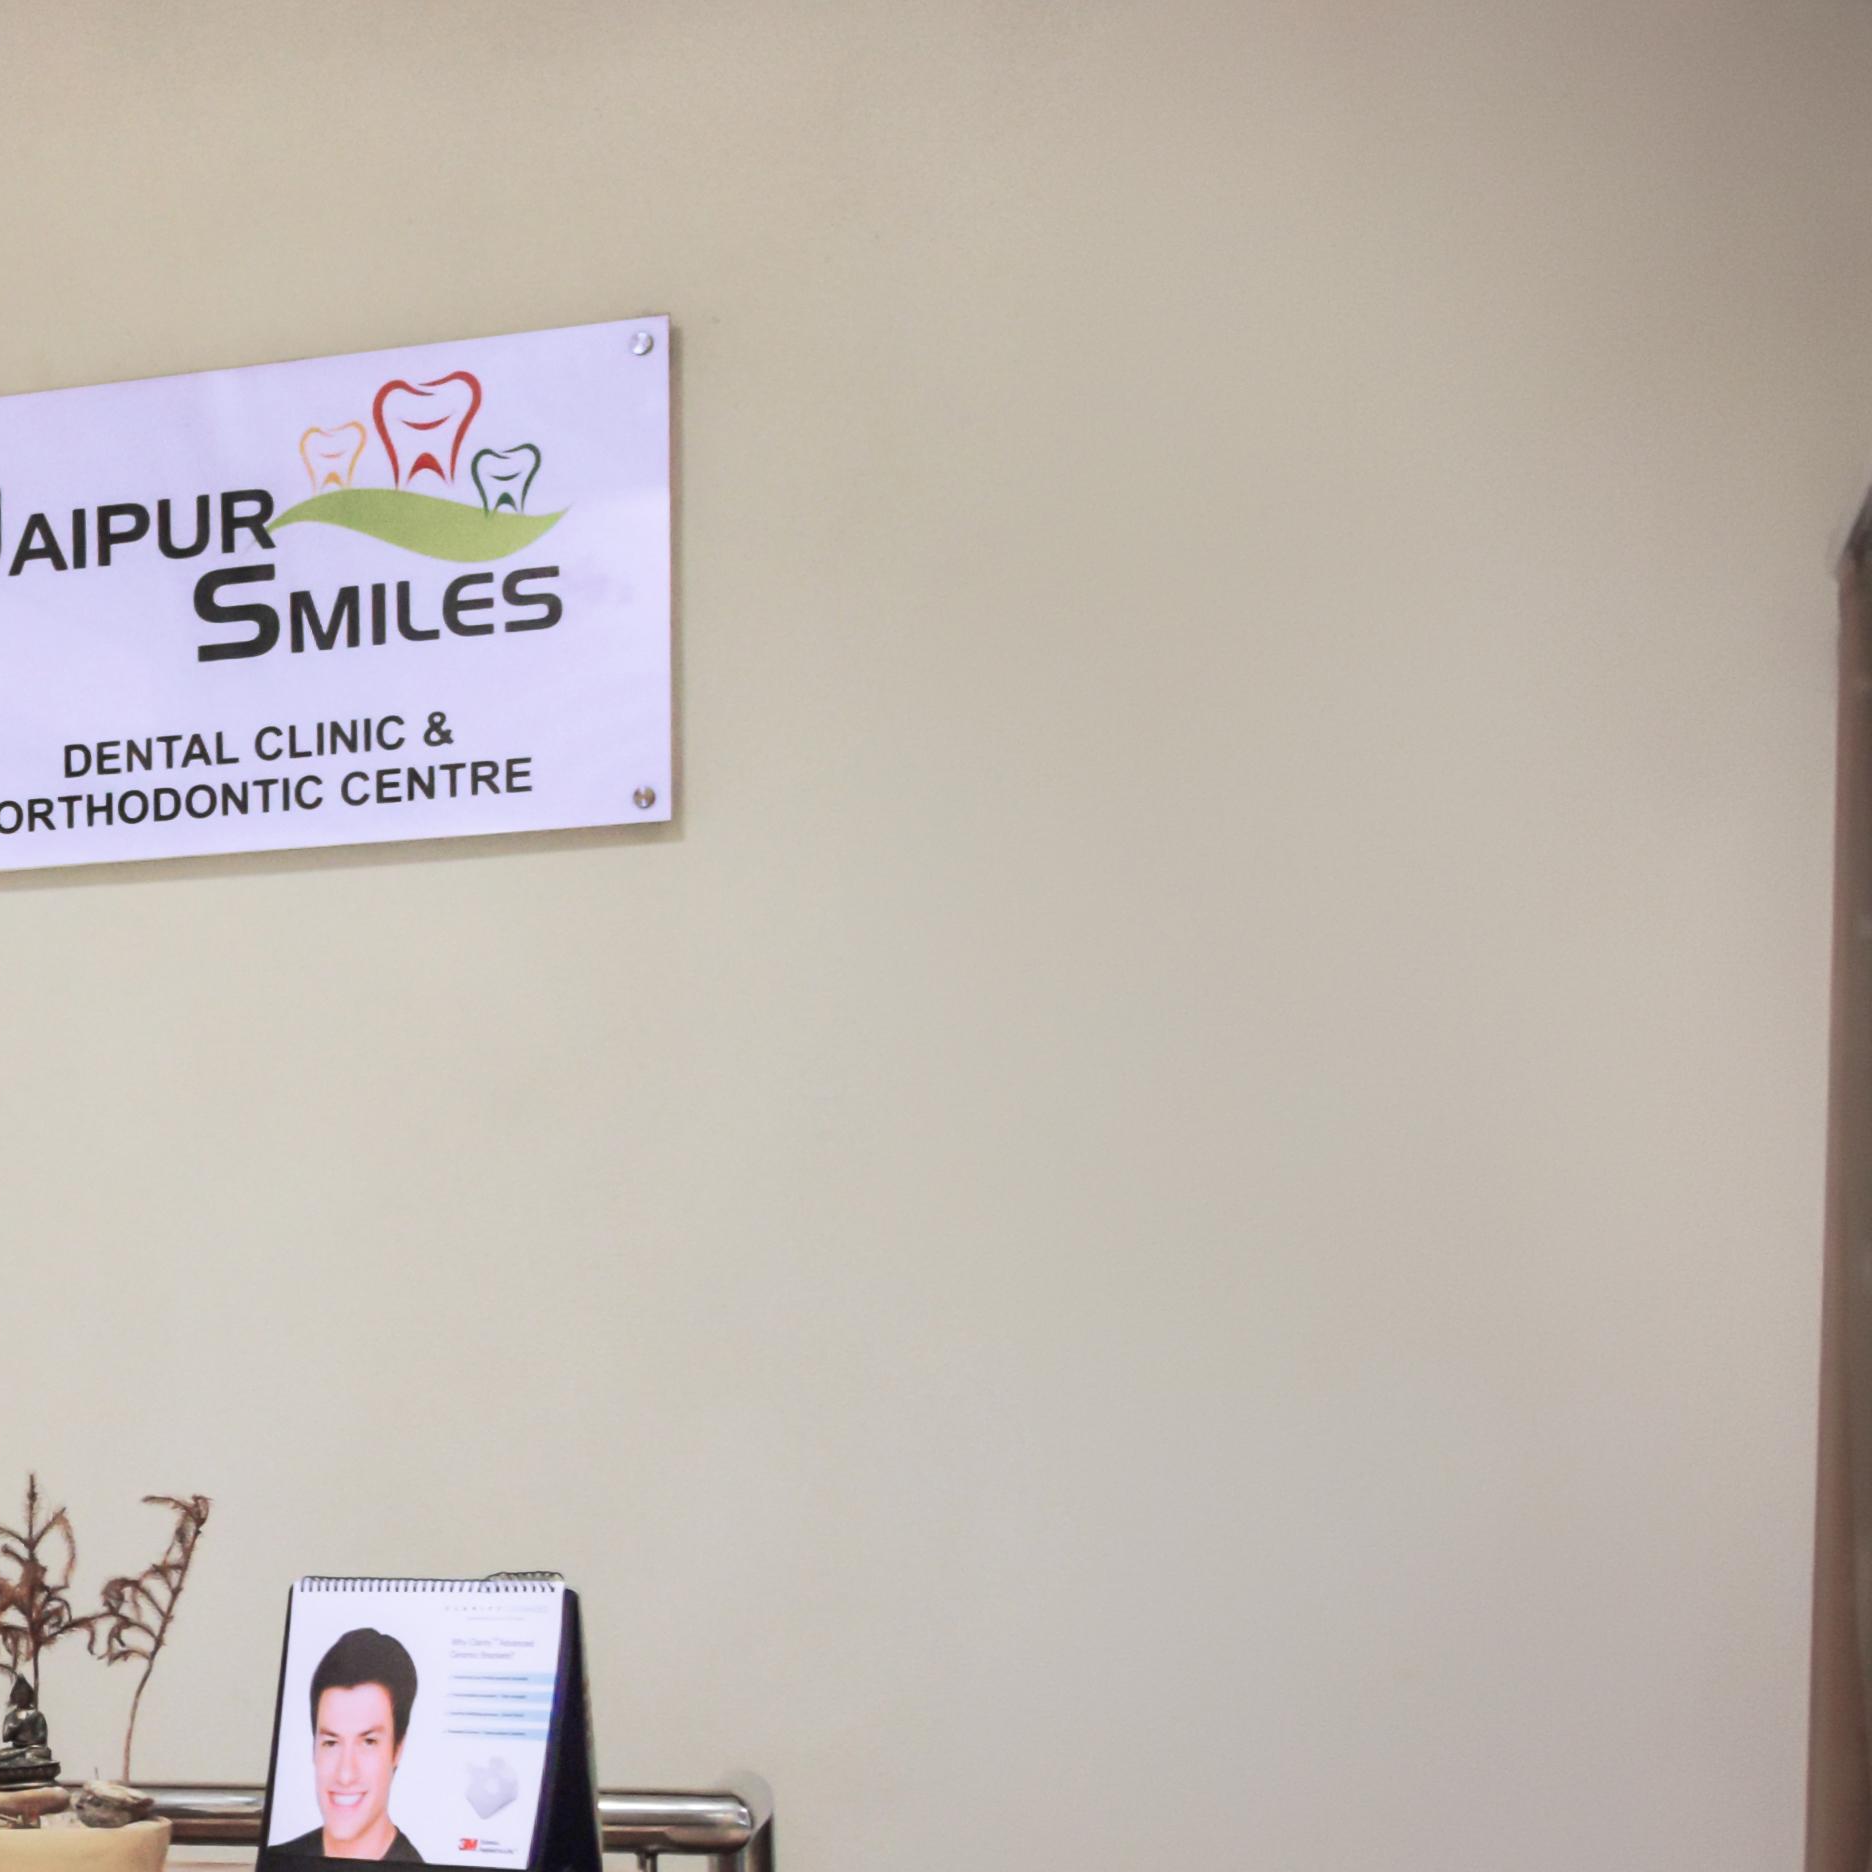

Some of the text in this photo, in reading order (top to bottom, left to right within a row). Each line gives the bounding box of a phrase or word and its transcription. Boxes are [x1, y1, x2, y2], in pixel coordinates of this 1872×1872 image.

[193, 563, 563, 662] SMILES
[64, 711, 455, 779] DENTAL CLINIC &
[341, 757, 533, 807] CENTRE
